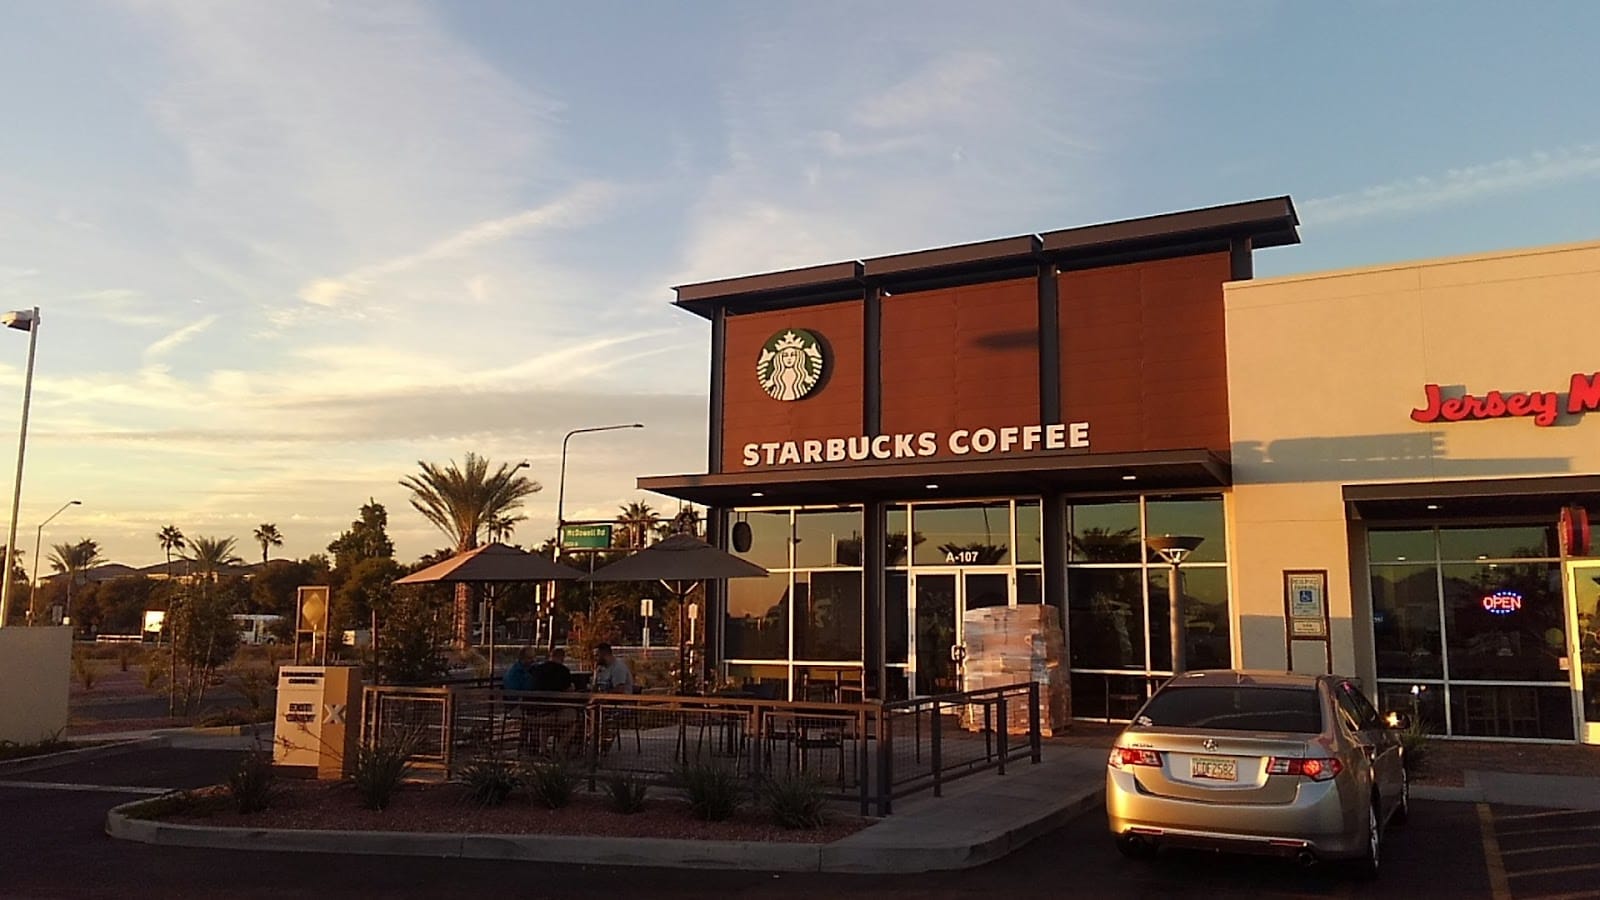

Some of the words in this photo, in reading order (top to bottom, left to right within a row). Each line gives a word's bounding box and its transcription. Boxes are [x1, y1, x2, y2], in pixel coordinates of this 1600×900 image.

[1410, 384, 1558, 427] Jersey
[743, 432, 937, 466] STARBUCKS
[949, 422, 1090, 455] COFFEE
[945, 551, 979, 563] A-107
[1483, 595, 1522, 611] OPEN
